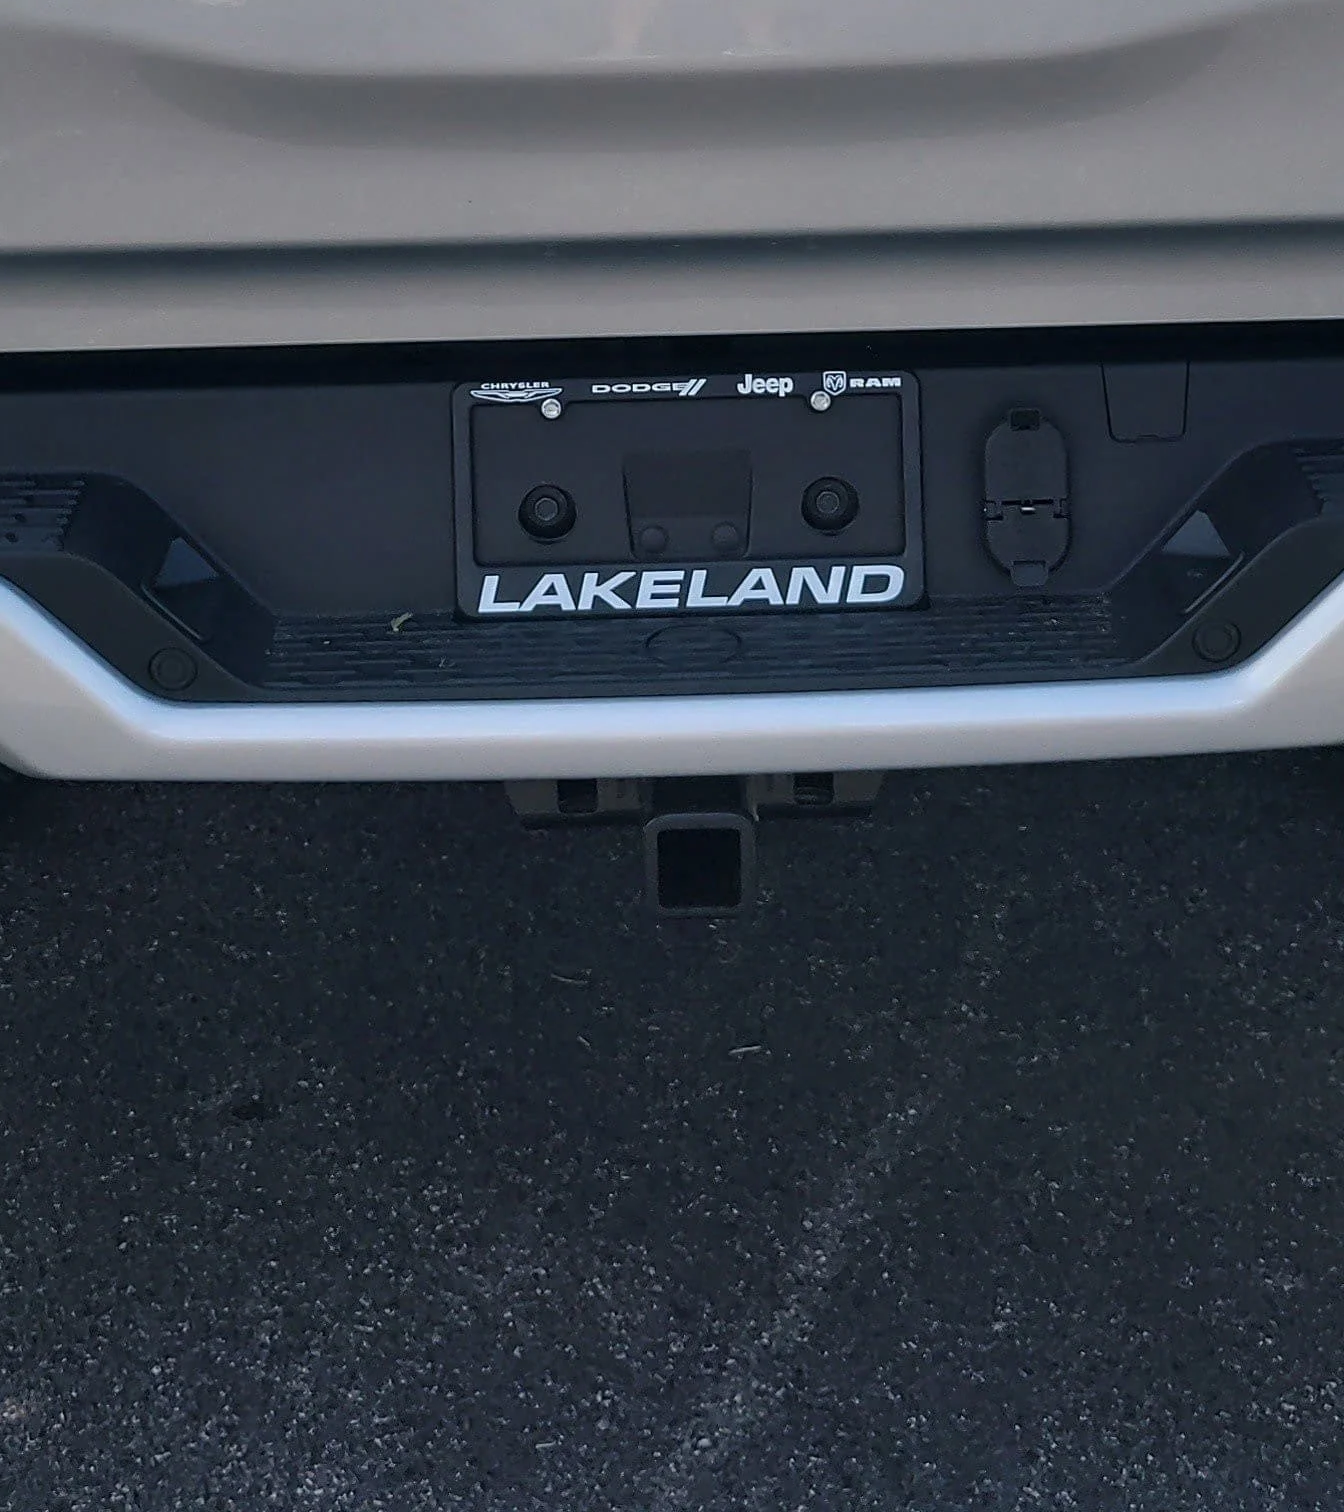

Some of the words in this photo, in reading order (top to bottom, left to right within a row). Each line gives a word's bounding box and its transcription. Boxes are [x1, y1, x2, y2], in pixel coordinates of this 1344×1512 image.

[480, 381, 550, 390] CHRYSLER
[591, 381, 688, 394] DODGE
[737, 373, 794, 398] Jeep
[849, 377, 902, 388] RAM
[477, 565, 905, 613] LAKELAND
